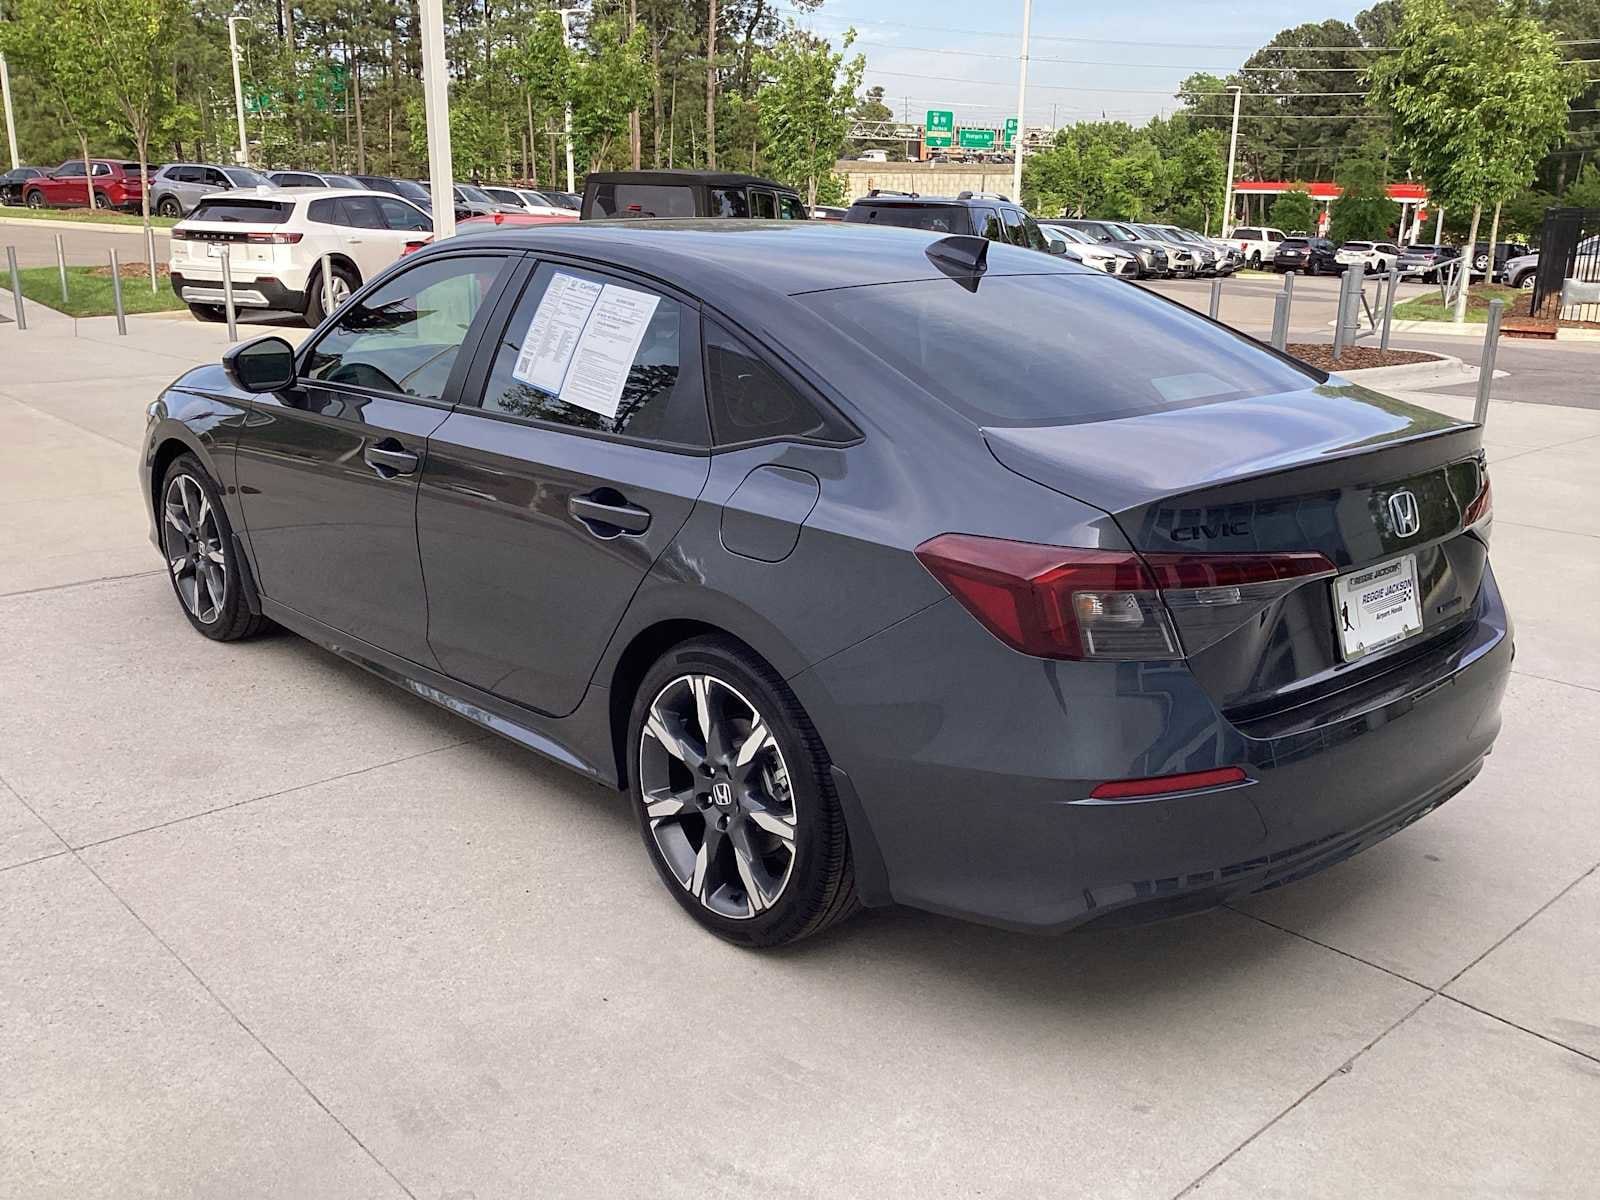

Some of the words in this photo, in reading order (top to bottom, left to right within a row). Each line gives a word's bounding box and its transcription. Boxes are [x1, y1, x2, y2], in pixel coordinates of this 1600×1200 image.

[1170, 520, 1249, 542] CIVIC
[1362, 588, 1384, 604] REGGIE
[1385, 579, 1412, 596] JACKSON
